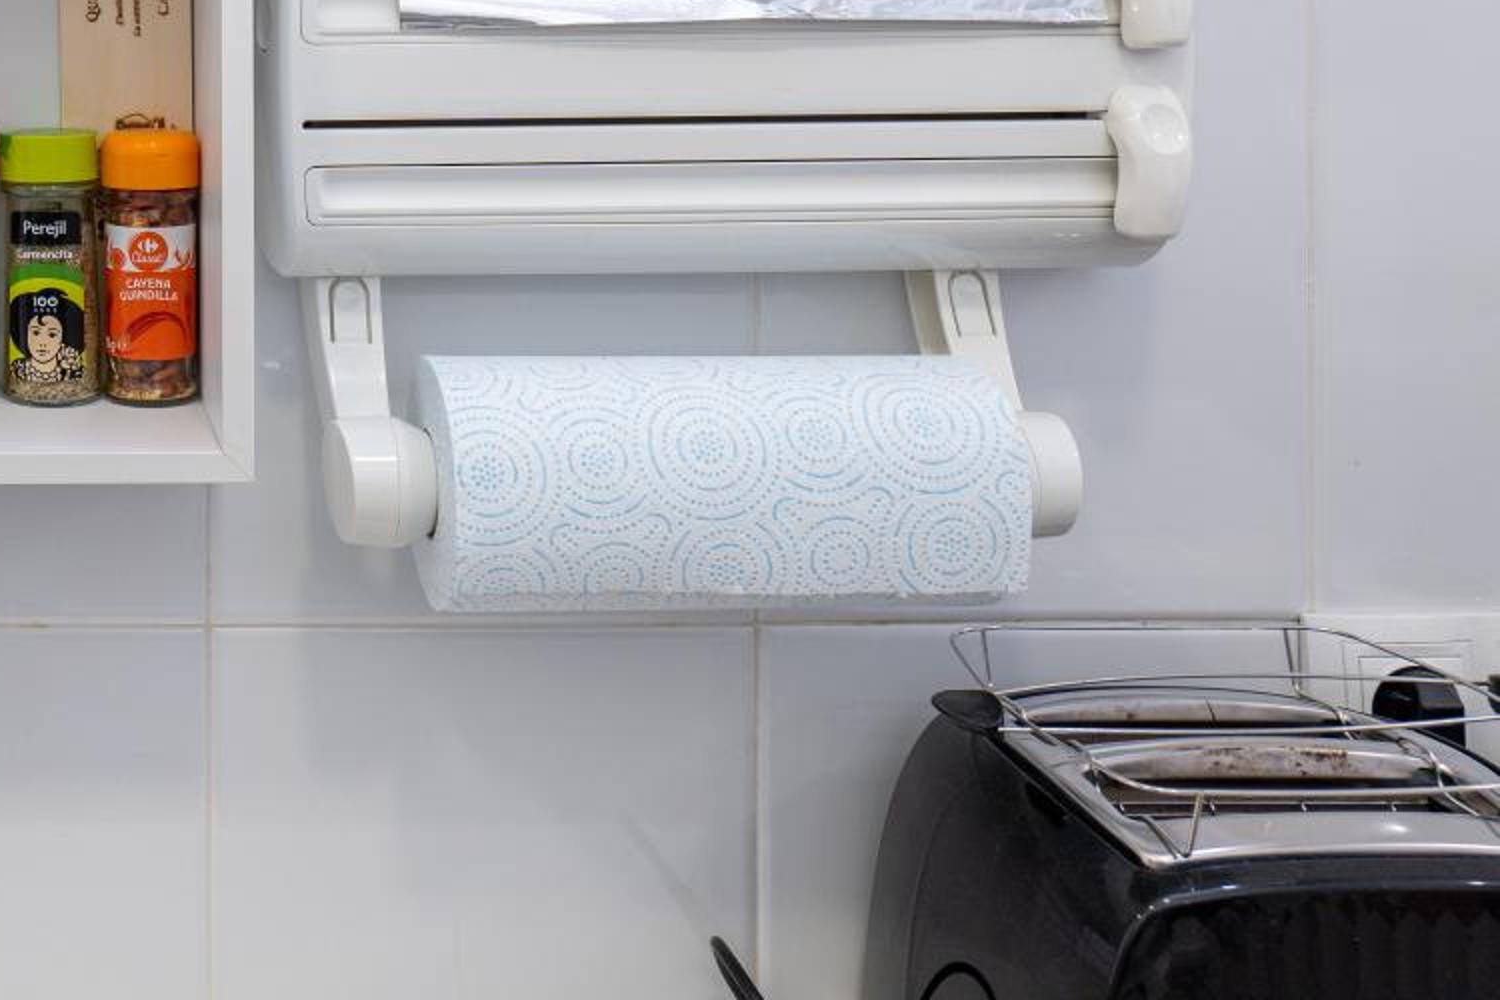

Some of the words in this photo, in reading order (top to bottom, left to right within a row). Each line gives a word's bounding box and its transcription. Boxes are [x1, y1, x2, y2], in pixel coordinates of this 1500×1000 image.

[23, 219, 67, 238] Perejil
[125, 277, 171, 289] CAYENA
[32, 296, 60, 307] 100
